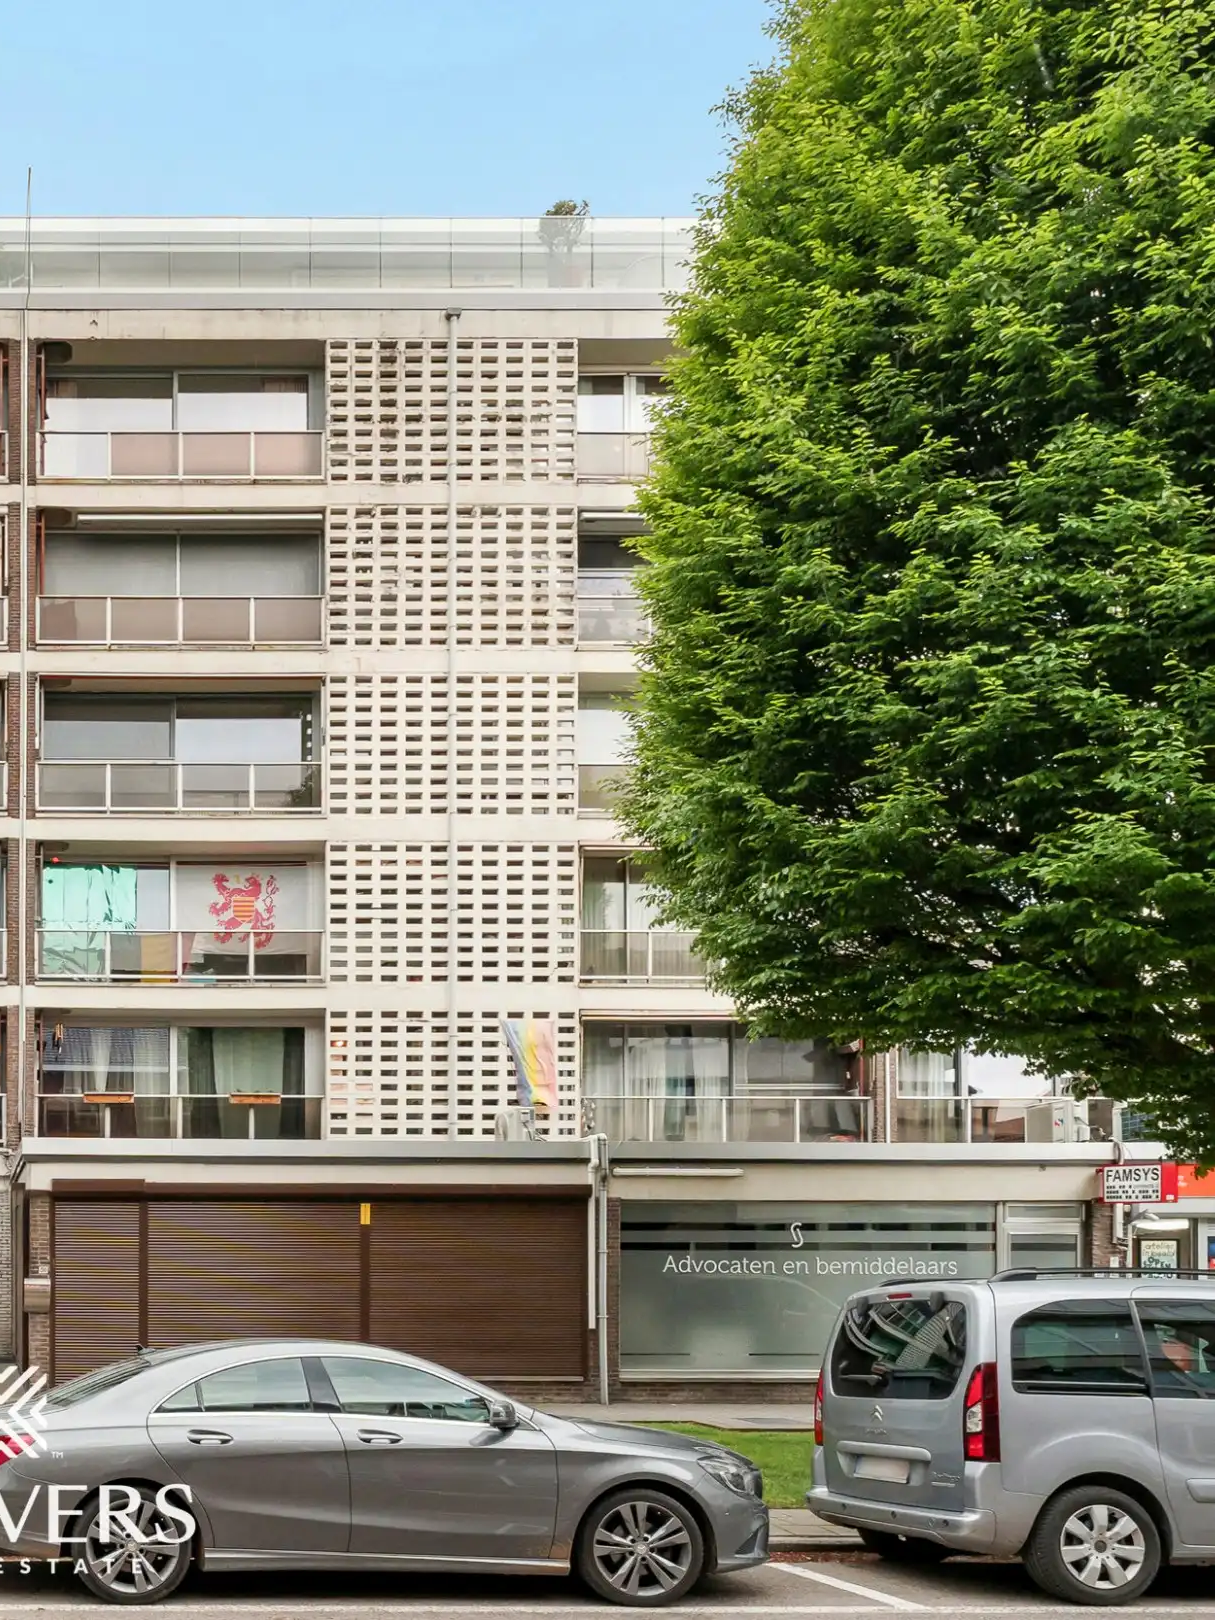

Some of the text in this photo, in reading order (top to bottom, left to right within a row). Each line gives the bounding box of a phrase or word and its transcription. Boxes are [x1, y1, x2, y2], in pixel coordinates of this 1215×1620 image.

[1106, 1167, 1160, 1182] FAMSYS
[663, 1255, 958, 1275] Advocaten en bemiddelaars
